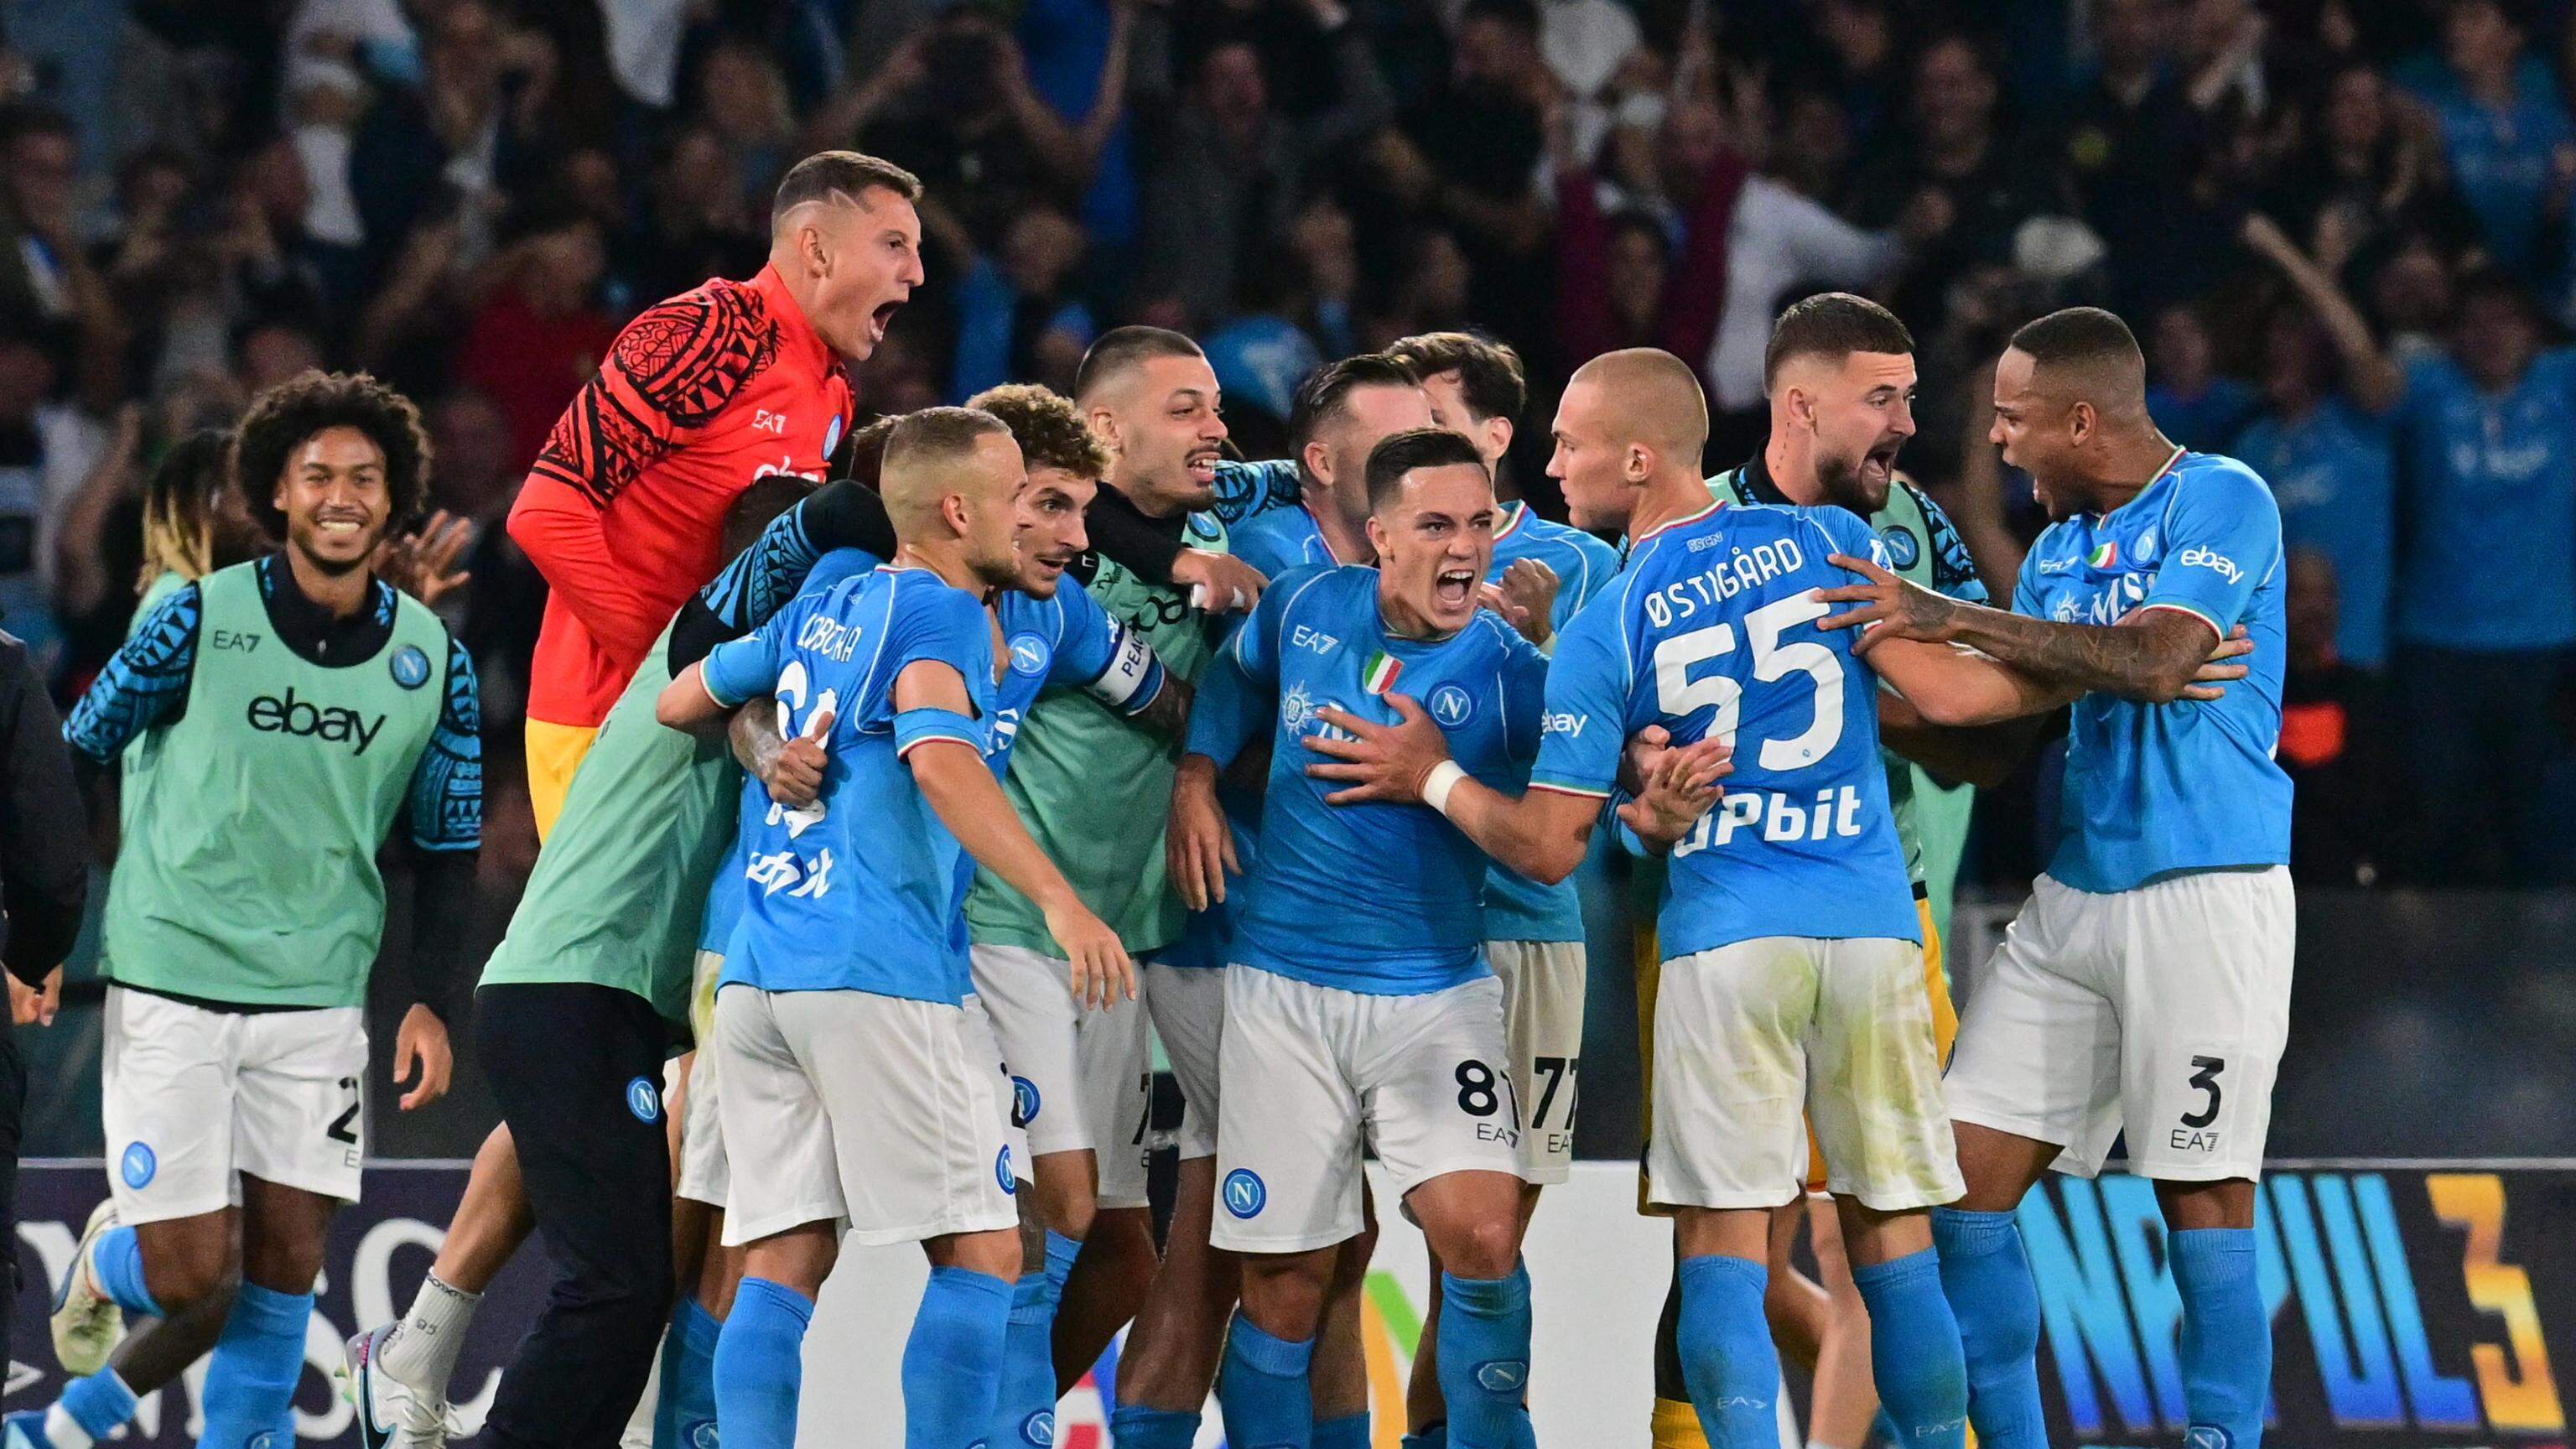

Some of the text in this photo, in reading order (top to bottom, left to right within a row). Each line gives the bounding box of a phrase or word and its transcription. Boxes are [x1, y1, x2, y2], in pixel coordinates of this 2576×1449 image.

[2181, 545, 2244, 585] ebay
[1645, 538, 1803, 628] ØSTIGÅRD
[213, 630, 261, 653] EA7
[1292, 624, 1339, 655] EA7
[1015, 641, 1040, 668] N
[1654, 587, 1844, 771] 55
[1438, 692, 1466, 719] N
[247, 686, 387, 756] ebay
[638, 1088, 652, 1112] N
[2180, 1055, 2225, 1129] 3
[1477, 1123, 1519, 1149] EA7
[2170, 1129, 2220, 1152] EA7
[1233, 1182, 1253, 1206] N
